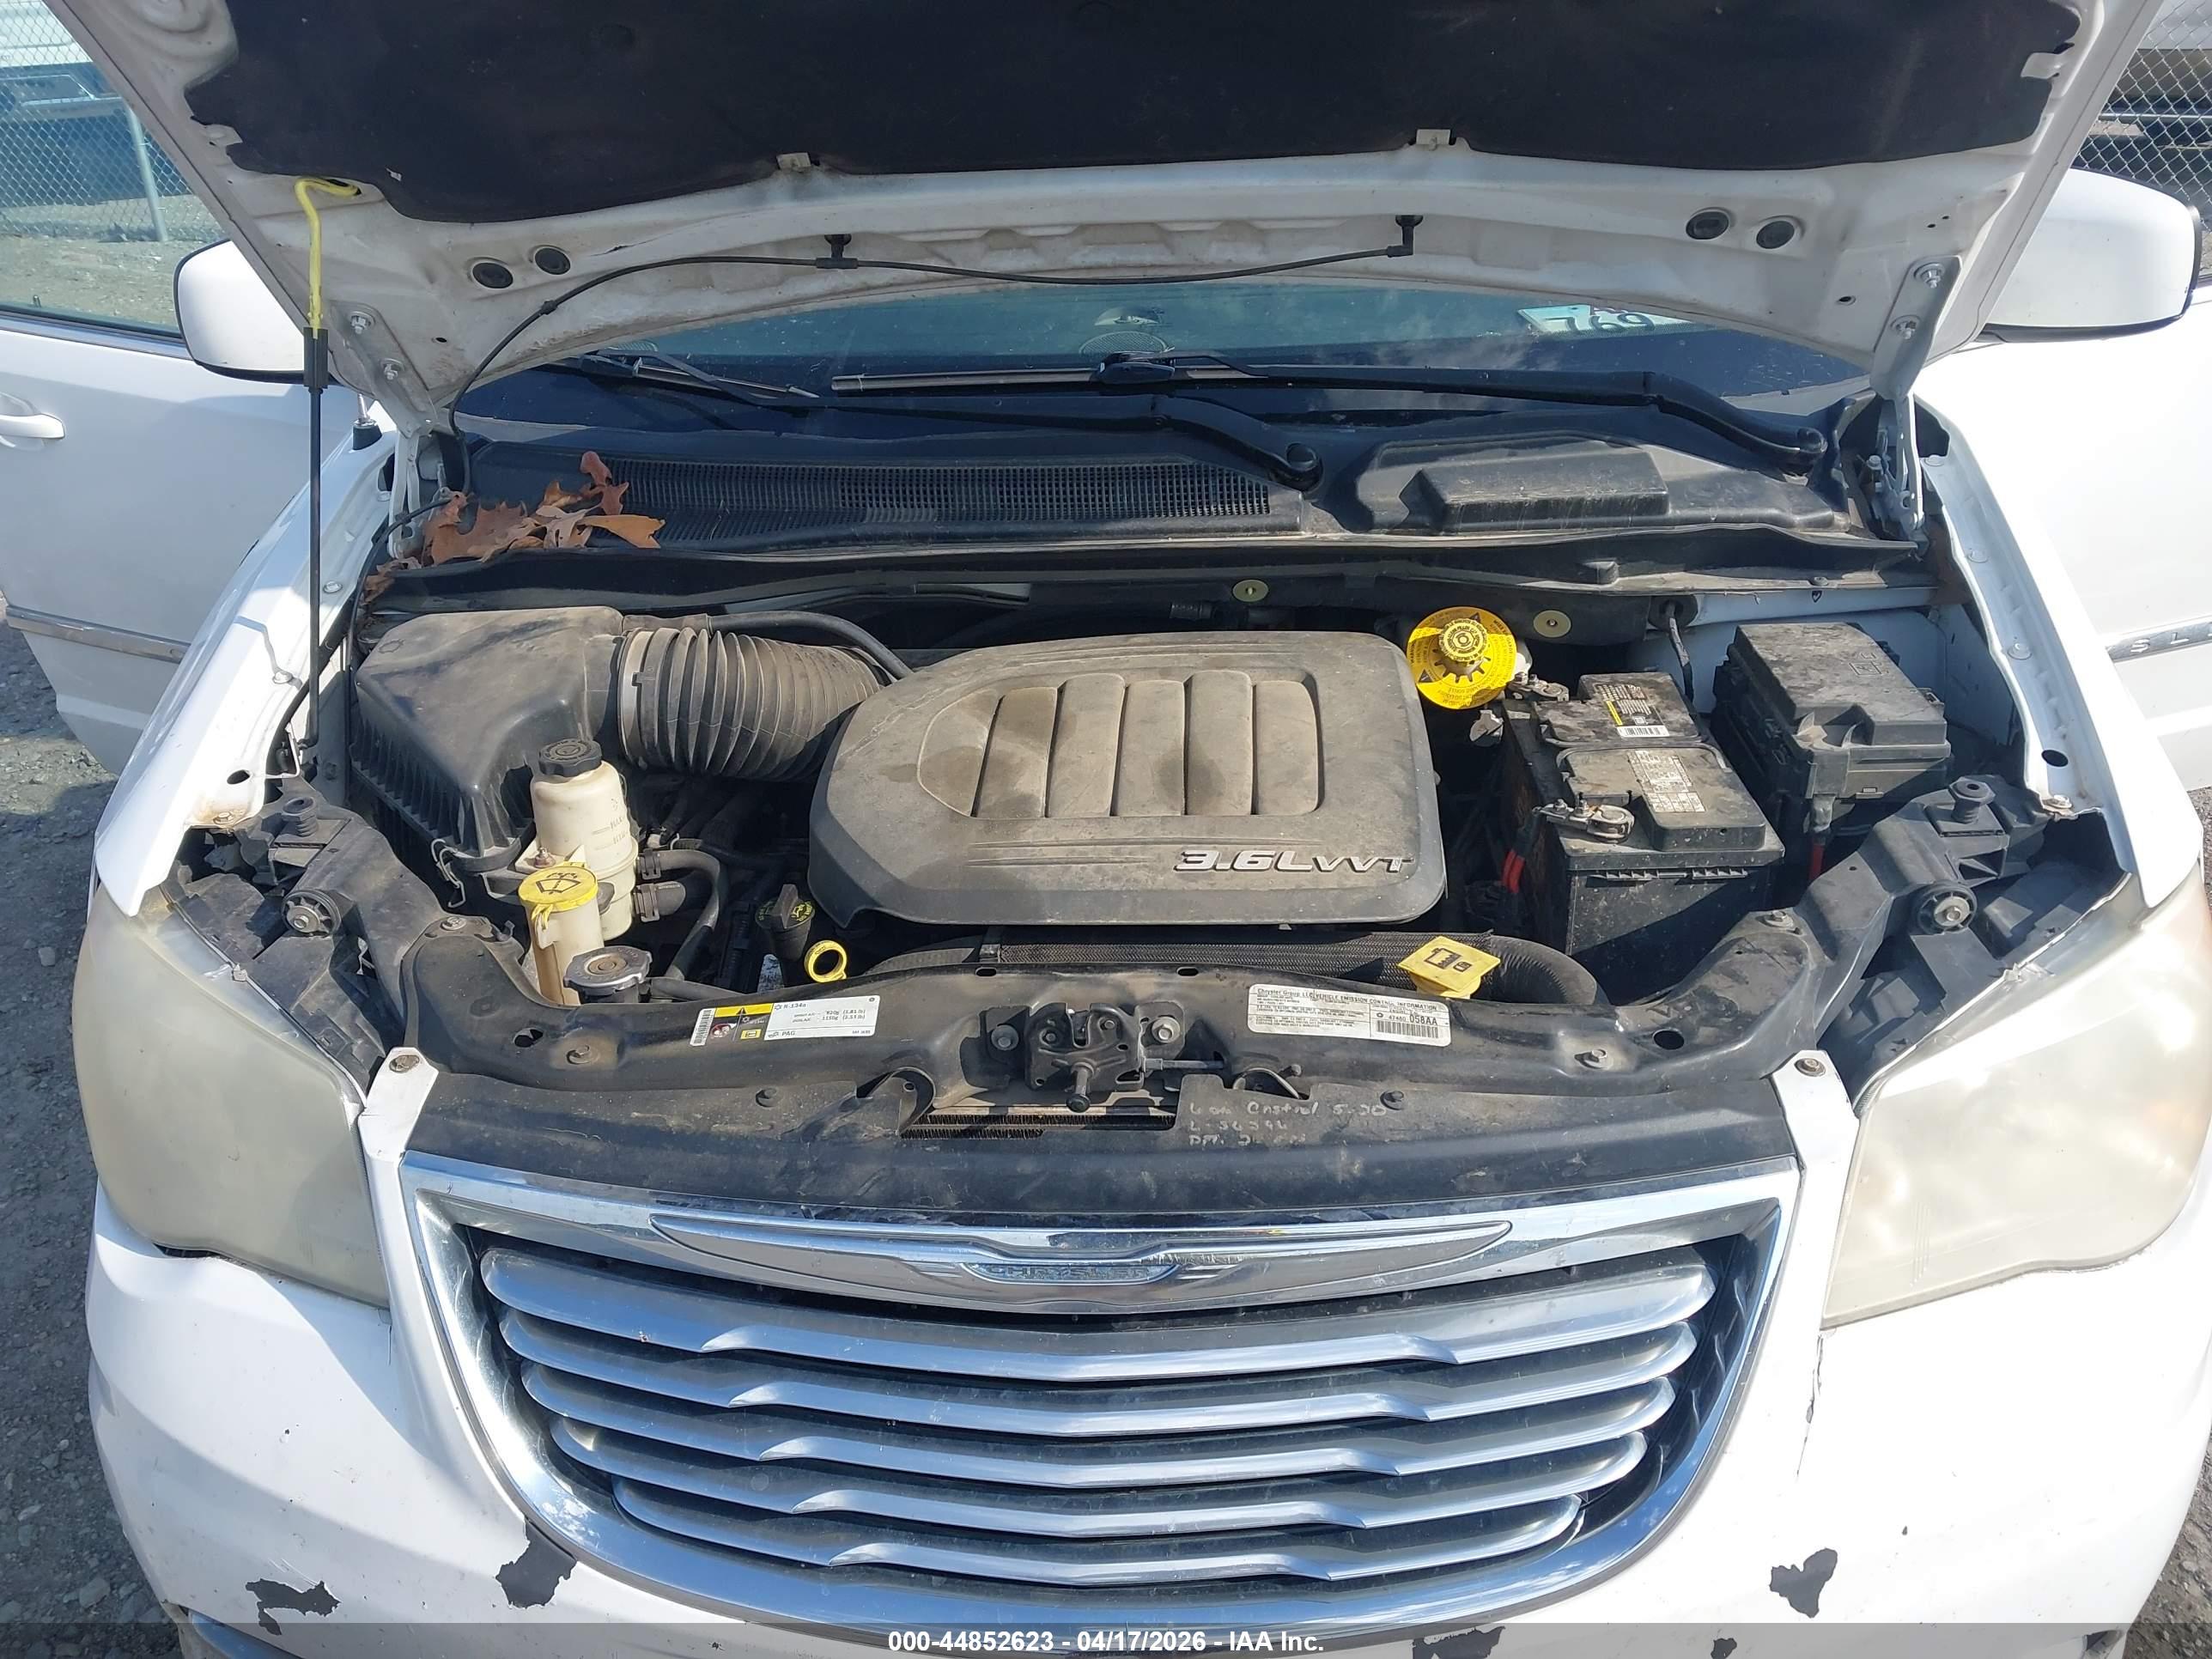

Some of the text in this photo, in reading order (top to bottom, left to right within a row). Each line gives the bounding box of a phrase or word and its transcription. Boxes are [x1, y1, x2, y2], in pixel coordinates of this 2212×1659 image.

[1397, 1001, 1437, 1011] INFORMATION
[1409, 1014, 1437, 1026] 058AA
[988, 1266, 1148, 1279] CHRYSLER
